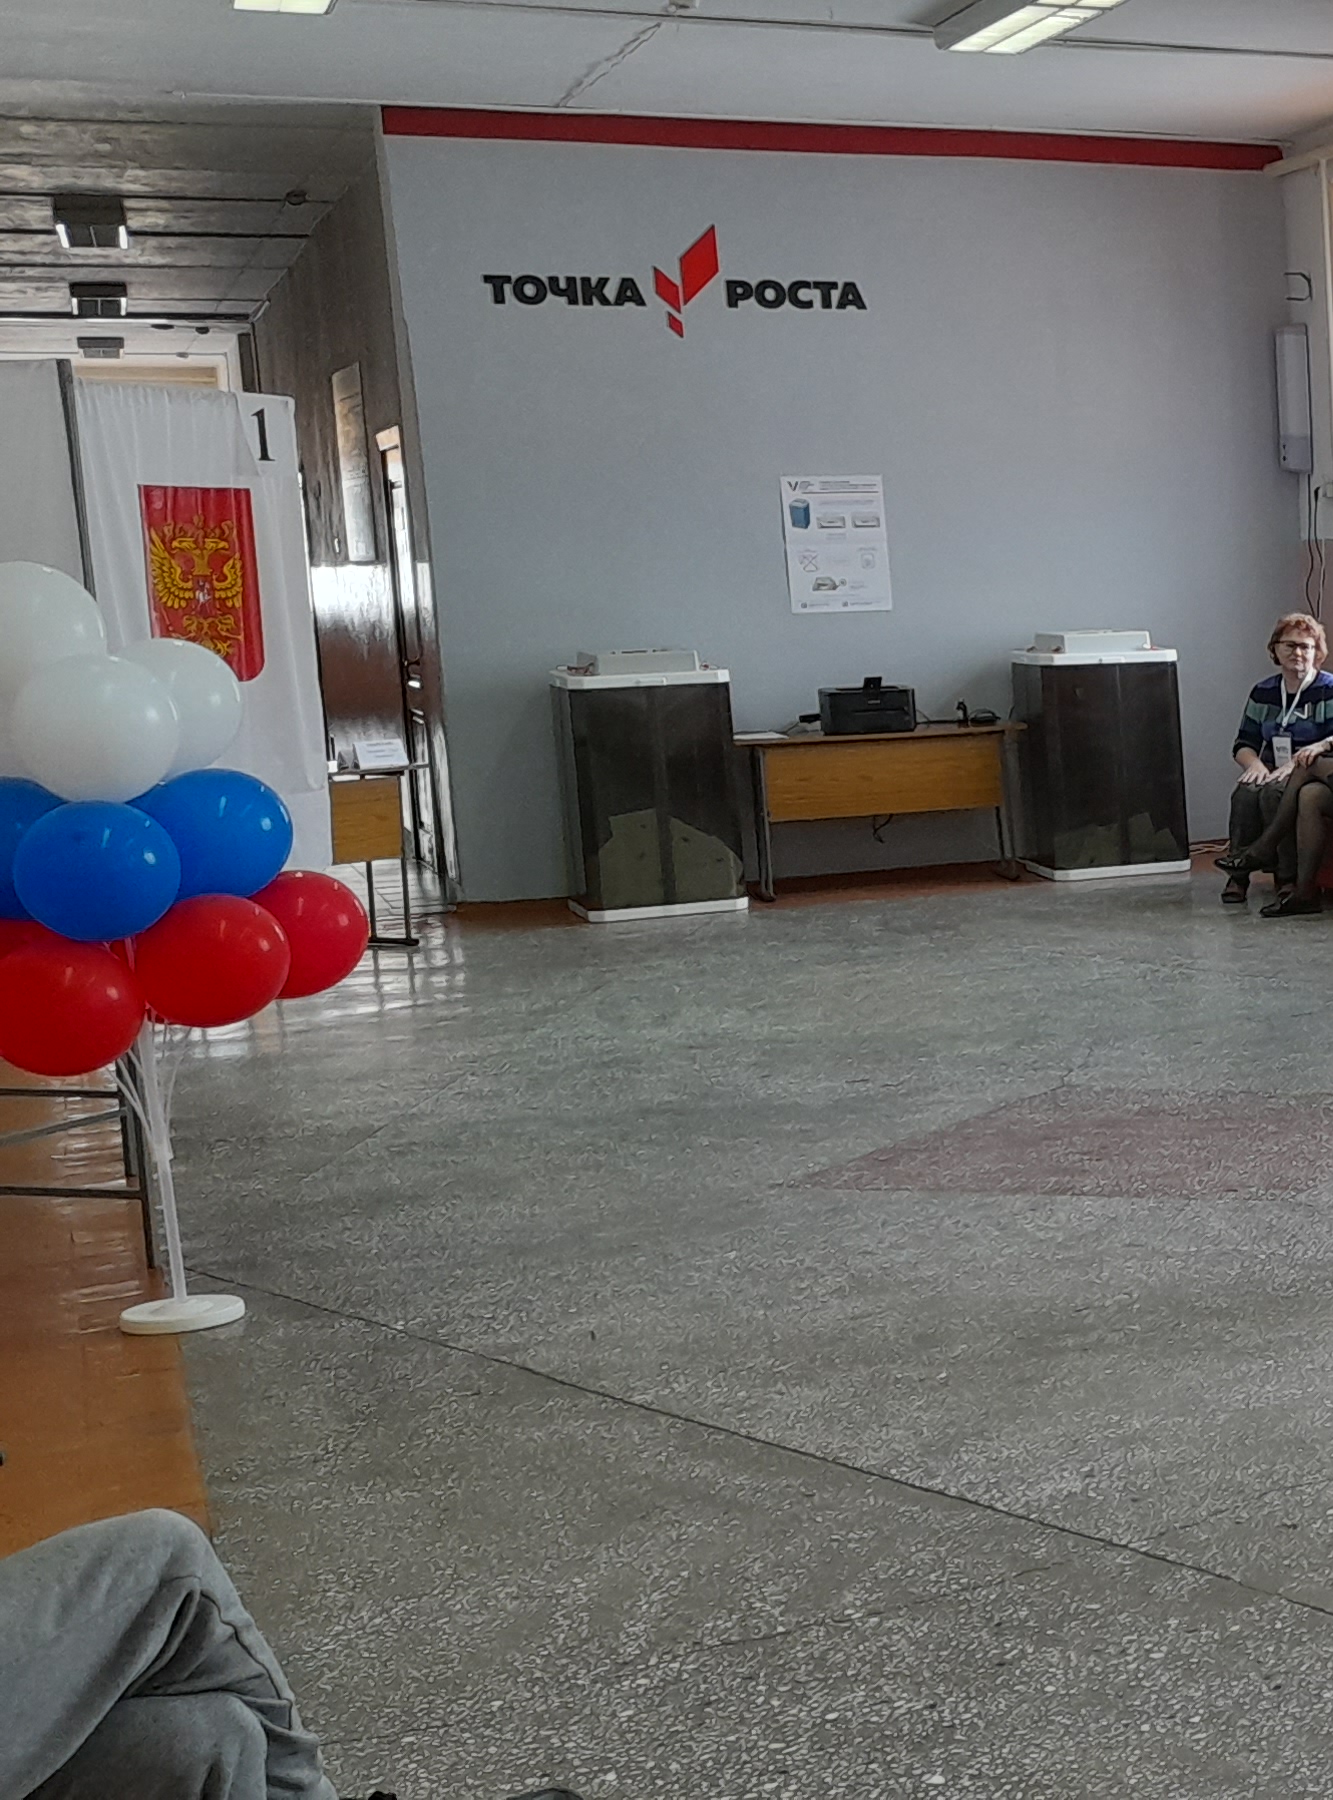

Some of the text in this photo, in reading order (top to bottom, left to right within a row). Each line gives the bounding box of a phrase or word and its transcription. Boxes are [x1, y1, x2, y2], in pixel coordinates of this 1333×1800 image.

[483, 275, 867, 310] ТОЧКА РОСТА
[251, 407, 275, 462] 1
